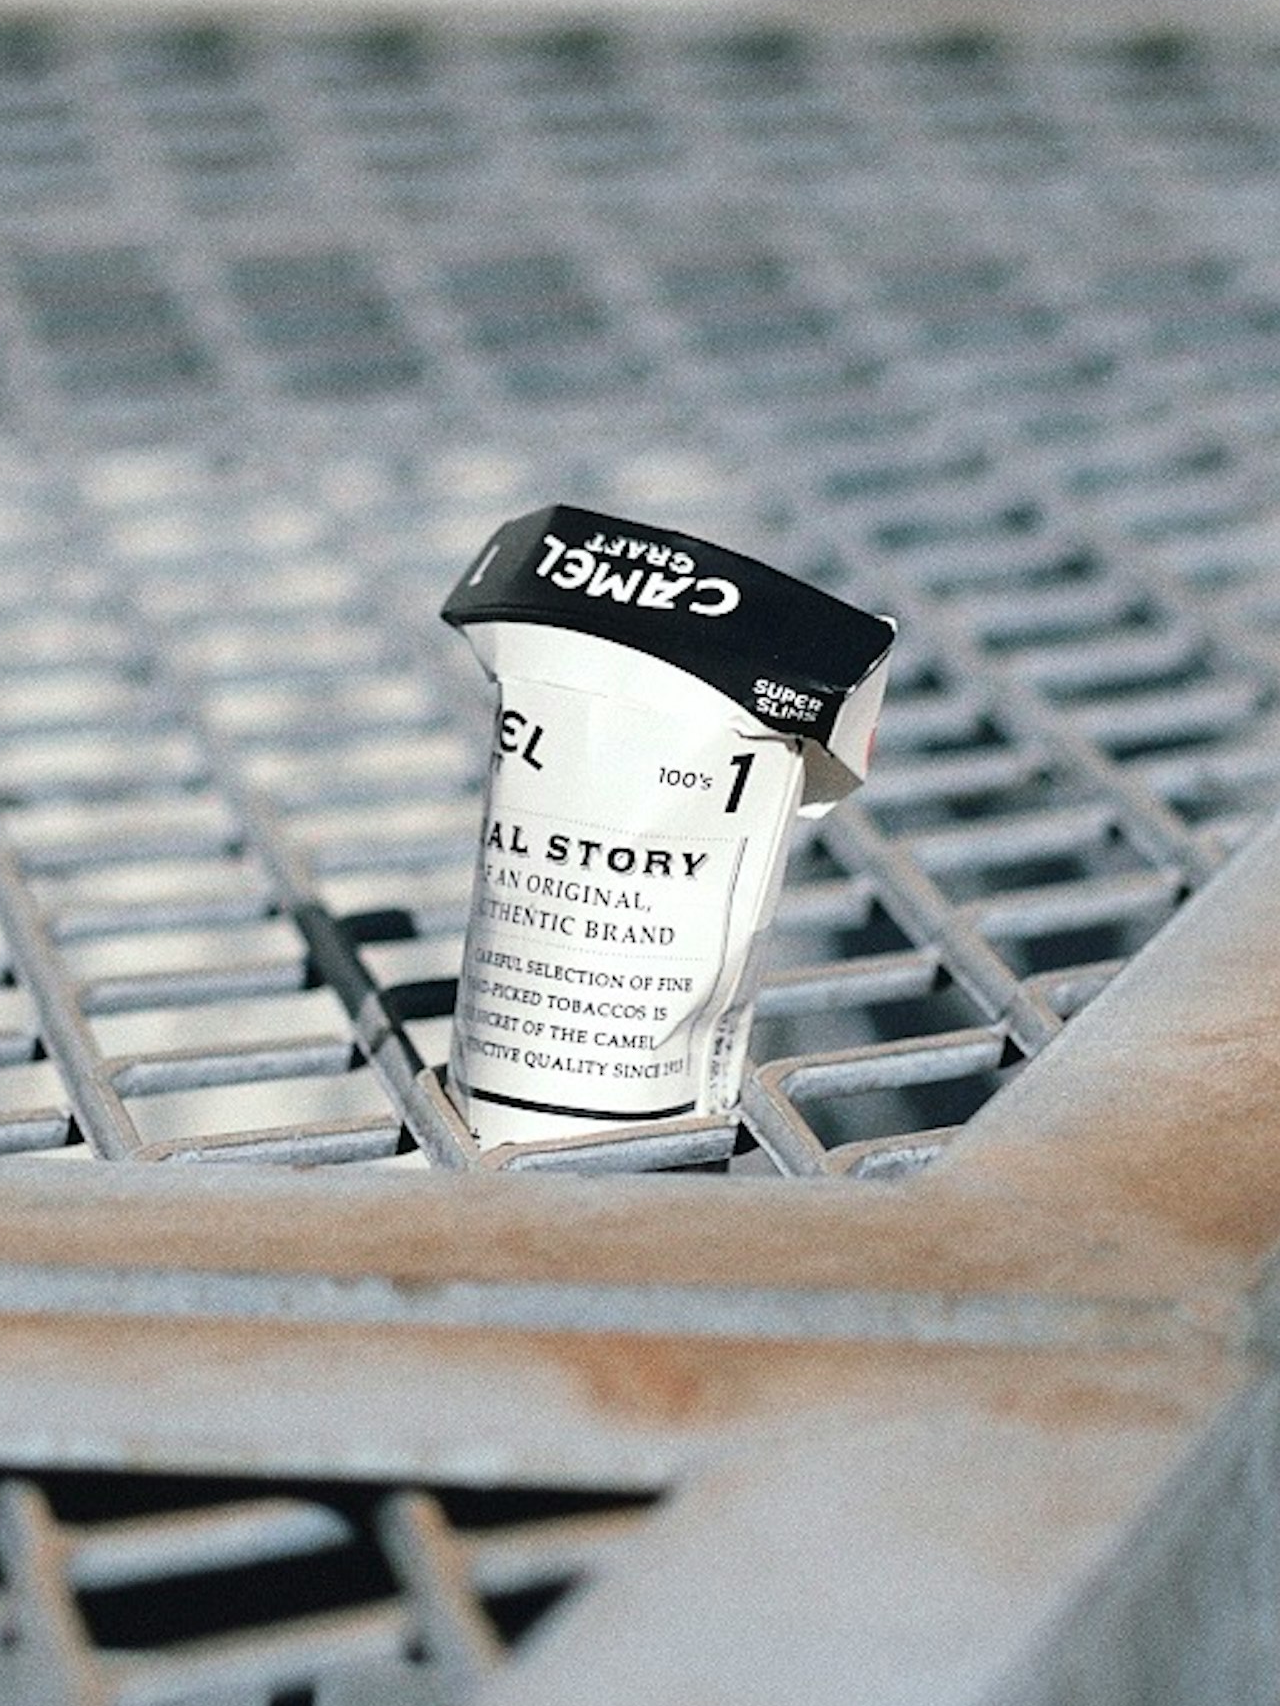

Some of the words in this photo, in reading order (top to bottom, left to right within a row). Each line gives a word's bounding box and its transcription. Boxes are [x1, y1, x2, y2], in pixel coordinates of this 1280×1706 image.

[584, 534, 696, 575] CRAFT
[535, 534, 740, 616] CAMEL
[752, 679, 824, 712] SUPER
[756, 697, 818, 722] SLIMS
[659, 767, 713, 790] 100's
[724, 753, 755, 813] 1
[545, 834, 708, 878] STORY
[496, 869, 520, 889] AN
[527, 875, 653, 912] ORIGINAL,
[584, 920, 676, 946] BRAND
[526, 959, 624, 990] SELECTION
[629, 974, 653, 990] OF
[656, 977, 694, 993] FINE
[547, 995, 647, 1020] TOBACCOS
[653, 1007, 668, 1021] IS
[522, 1019, 544, 1036] OF
[550, 1025, 587, 1044] THE
[593, 1032, 658, 1051] CAMEL
[523, 1049, 609, 1078] QUALITY
